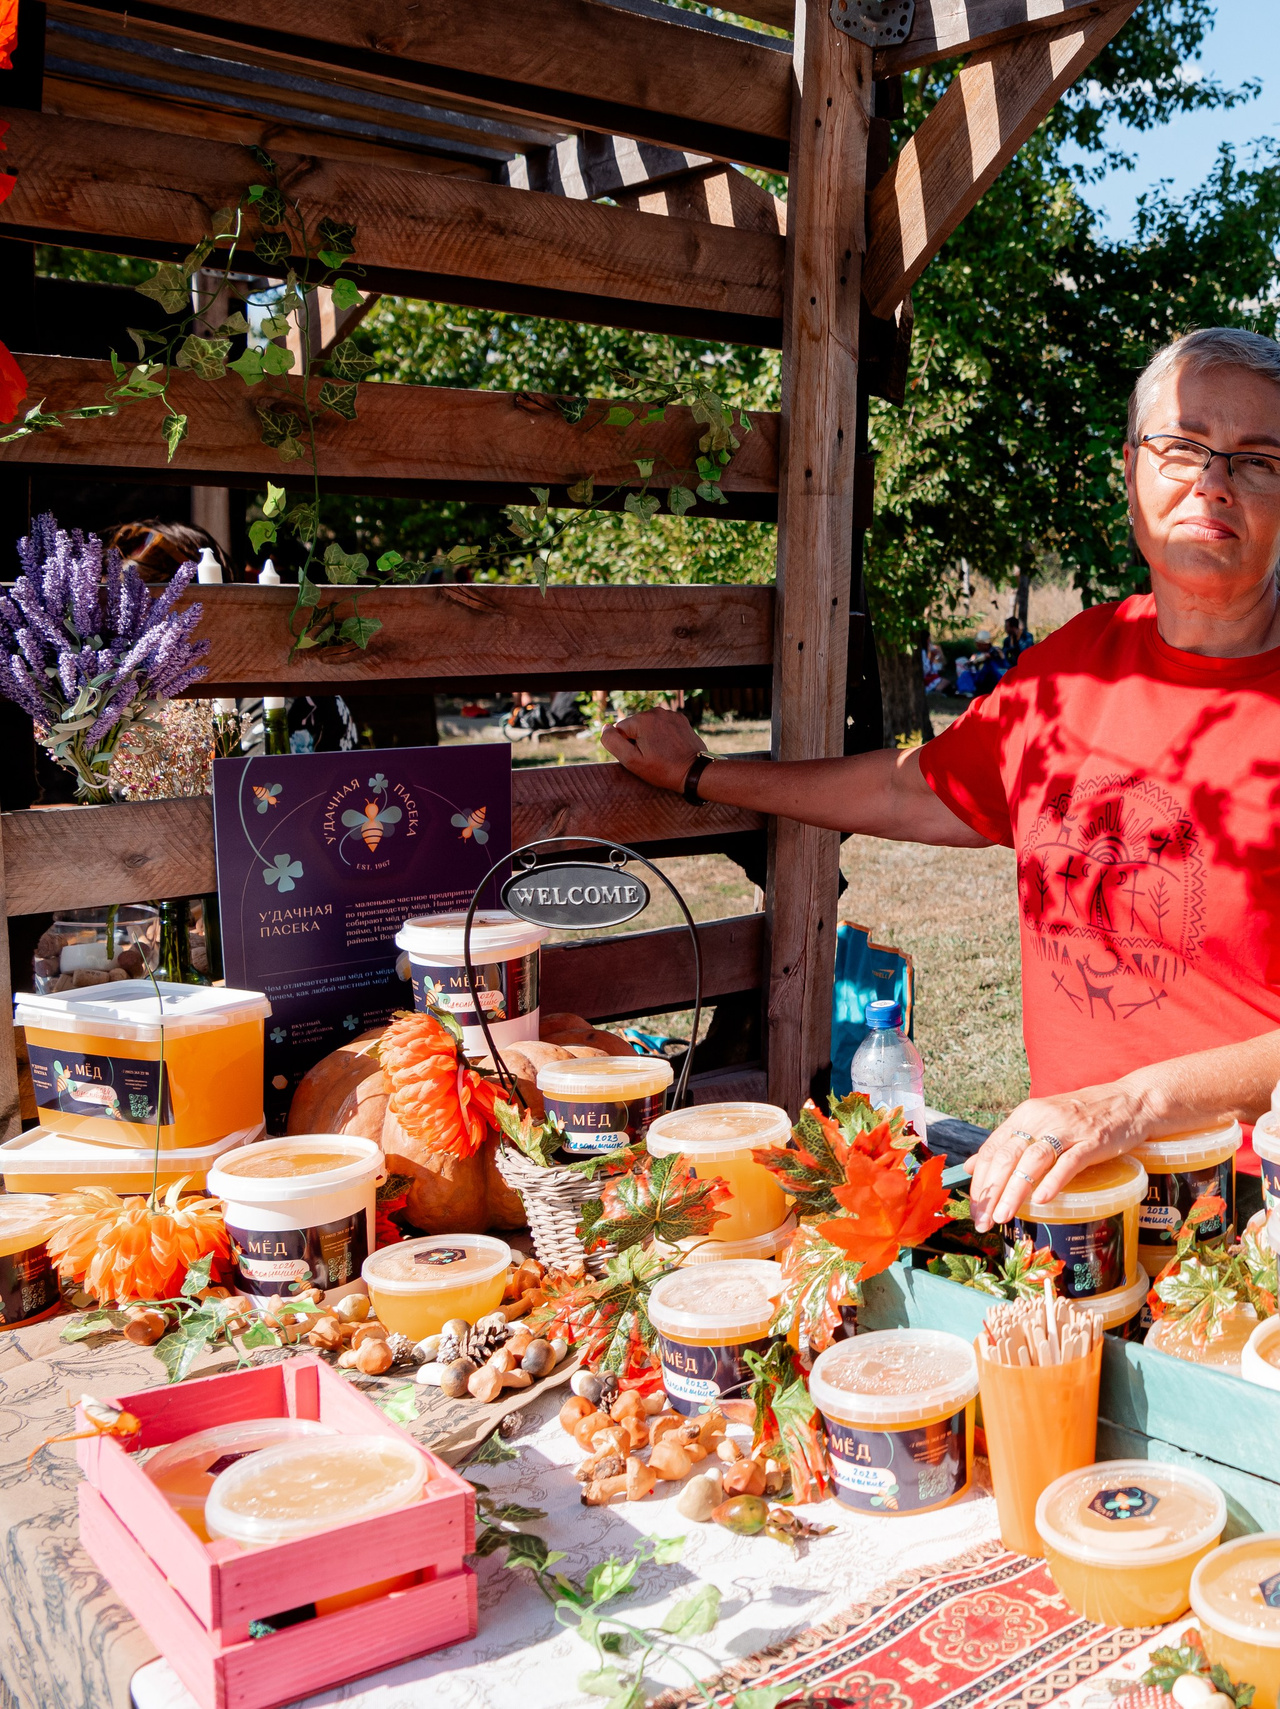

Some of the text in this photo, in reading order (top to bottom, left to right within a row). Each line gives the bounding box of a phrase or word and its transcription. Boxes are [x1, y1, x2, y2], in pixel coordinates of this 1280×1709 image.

[323, 778, 419, 845] У'ДАЧНАЯ ПАСЕКА
[356, 859, 391, 871] EST. 1967
[354, 898, 396, 909] маленькое
[396, 894, 428, 906] частное
[512, 885, 640, 906] WELCOME
[356, 905, 409, 918] производству
[433, 899, 455, 907] Наши
[258, 903, 333, 938] У'ДАЧНАЯ ПАСЕКА
[345, 918, 383, 928] собирают
[385, 914, 400, 923] мёд
[346, 936, 379, 947] районах
[264, 984, 282, 992] Чем
[282, 977, 329, 990] отличается
[329, 975, 347, 983] наш
[375, 968, 395, 976] мёда
[311, 985, 336, 995] любой
[337, 980, 371, 990] честный
[372, 975, 389, 985] мёд!
[449, 974, 487, 988] МЁД
[75, 1062, 103, 1081] МЁД
[573, 1111, 612, 1129] МЁД
[595, 1134, 619, 1143] 2023
[1147, 1205, 1170, 1216] 2023
[248, 1239, 288, 1257] МЁД
[272, 1261, 296, 1271] 2024
[664, 1349, 699, 1375] МЁД
[830, 1433, 872, 1463] МЁД
[852, 1467, 879, 1480] 2023
